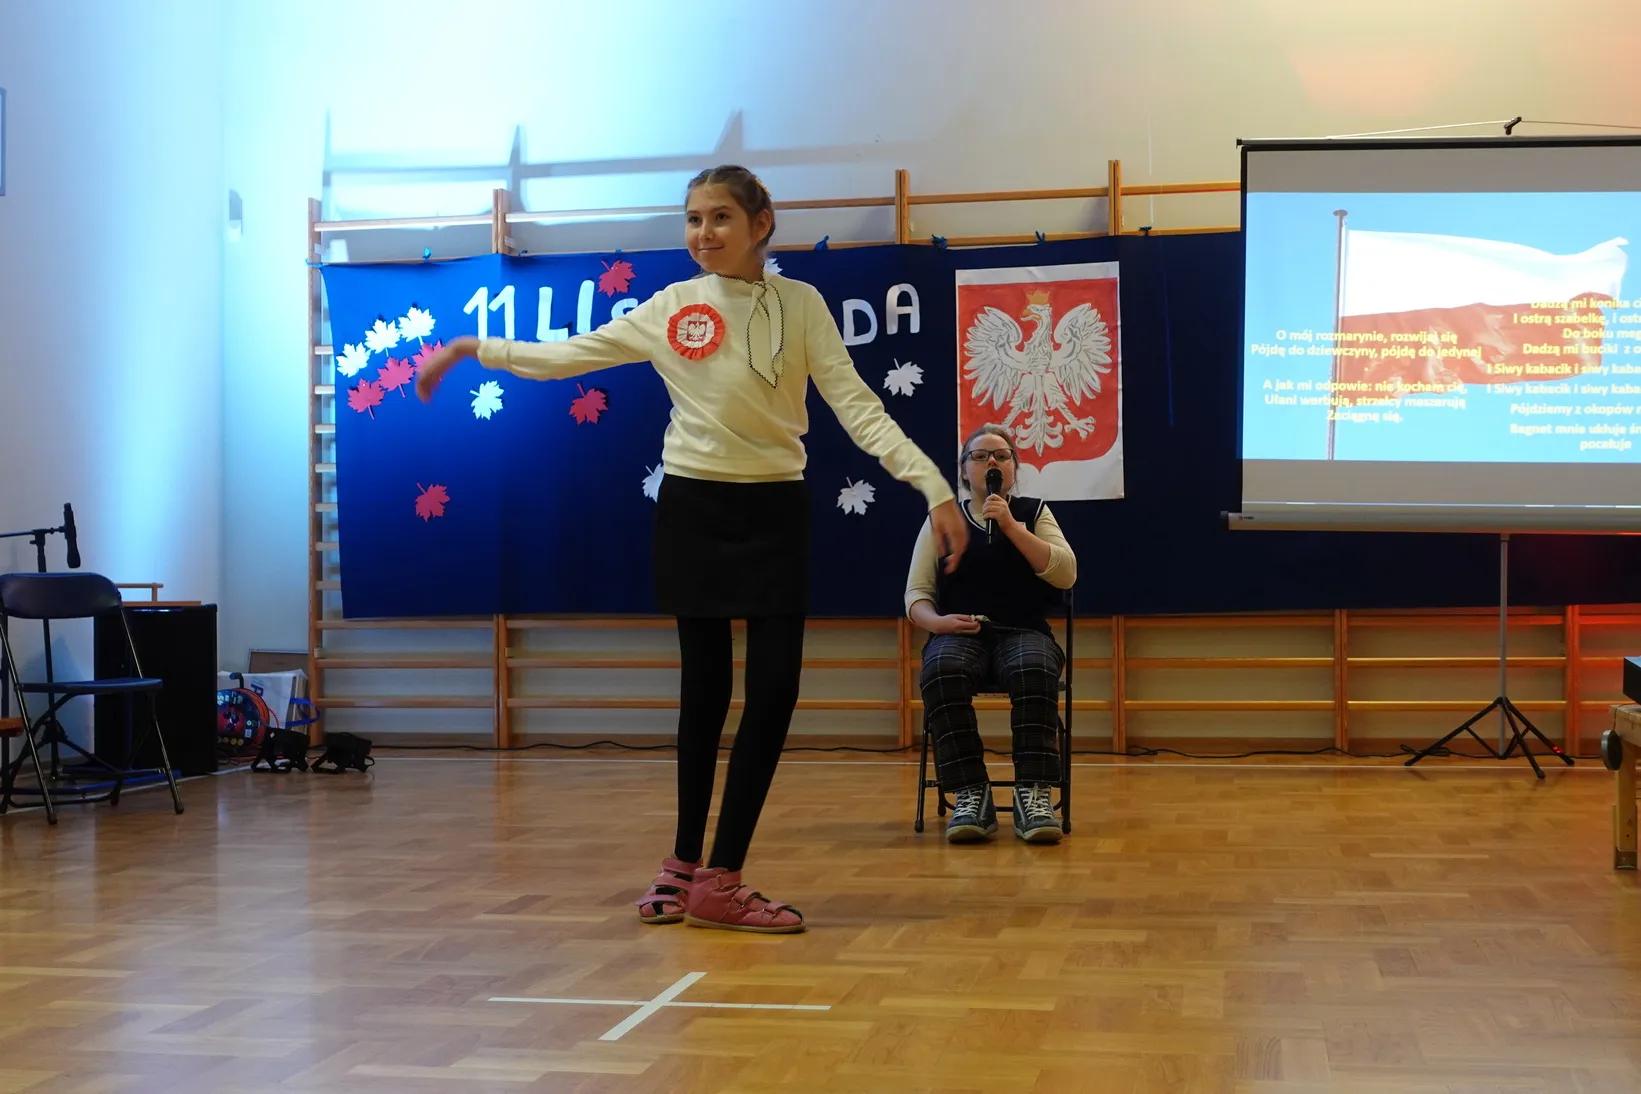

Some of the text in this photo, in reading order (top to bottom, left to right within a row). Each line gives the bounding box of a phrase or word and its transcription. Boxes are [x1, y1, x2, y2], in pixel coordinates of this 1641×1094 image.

[1531, 299, 1568, 310] Dadzą
[1570, 298, 1587, 308] mi
[1589, 298, 1630, 309] konika
[463, 284, 516, 341] 11
[1513, 313, 1518, 324] I
[1520, 314, 1552, 325] ostrą
[1555, 313, 1609, 326] szabelkę,
[1276, 330, 1287, 340] O
[1289, 329, 1312, 342] mój
[1315, 331, 1387, 344] rozmarynie,
[1440, 332, 1458, 344] się
[1562, 328, 1581, 339] Do
[1583, 328, 1614, 339] boku
[1251, 343, 1482, 360] Pójdę do dziewczyny, pójdę do jedynej
[1523, 343, 1560, 356] Dadzą
[1563, 343, 1579, 354] mi
[1581, 343, 1617, 354] buciki
[1623, 346, 1630, 354] z
[1494, 364, 1523, 376] Siwy
[1525, 364, 1571, 374] kabacik
[1581, 364, 1608, 376] siwy
[1263, 380, 1273, 389] A
[1275, 379, 1294, 391] jak
[1297, 380, 1312, 390] mi
[1315, 380, 1372, 393] odpowie:
[1375, 380, 1394, 391] nie
[1396, 381, 1444, 392] kocham
[1494, 383, 1522, 396] Siwy
[1525, 383, 1571, 394] kabacik
[1581, 383, 1608, 396] siwy
[1299, 394, 1354, 408] werbują,
[1510, 403, 1573, 416] Pójdziemy
[1574, 406, 1581, 414] z
[1583, 404, 1634, 416] okopów
[1510, 424, 1552, 436] Bagnet
[1555, 424, 1586, 434] mnie
[1589, 423, 1627, 436] ukłuje
[1580, 438, 1632, 451] pocałuje
